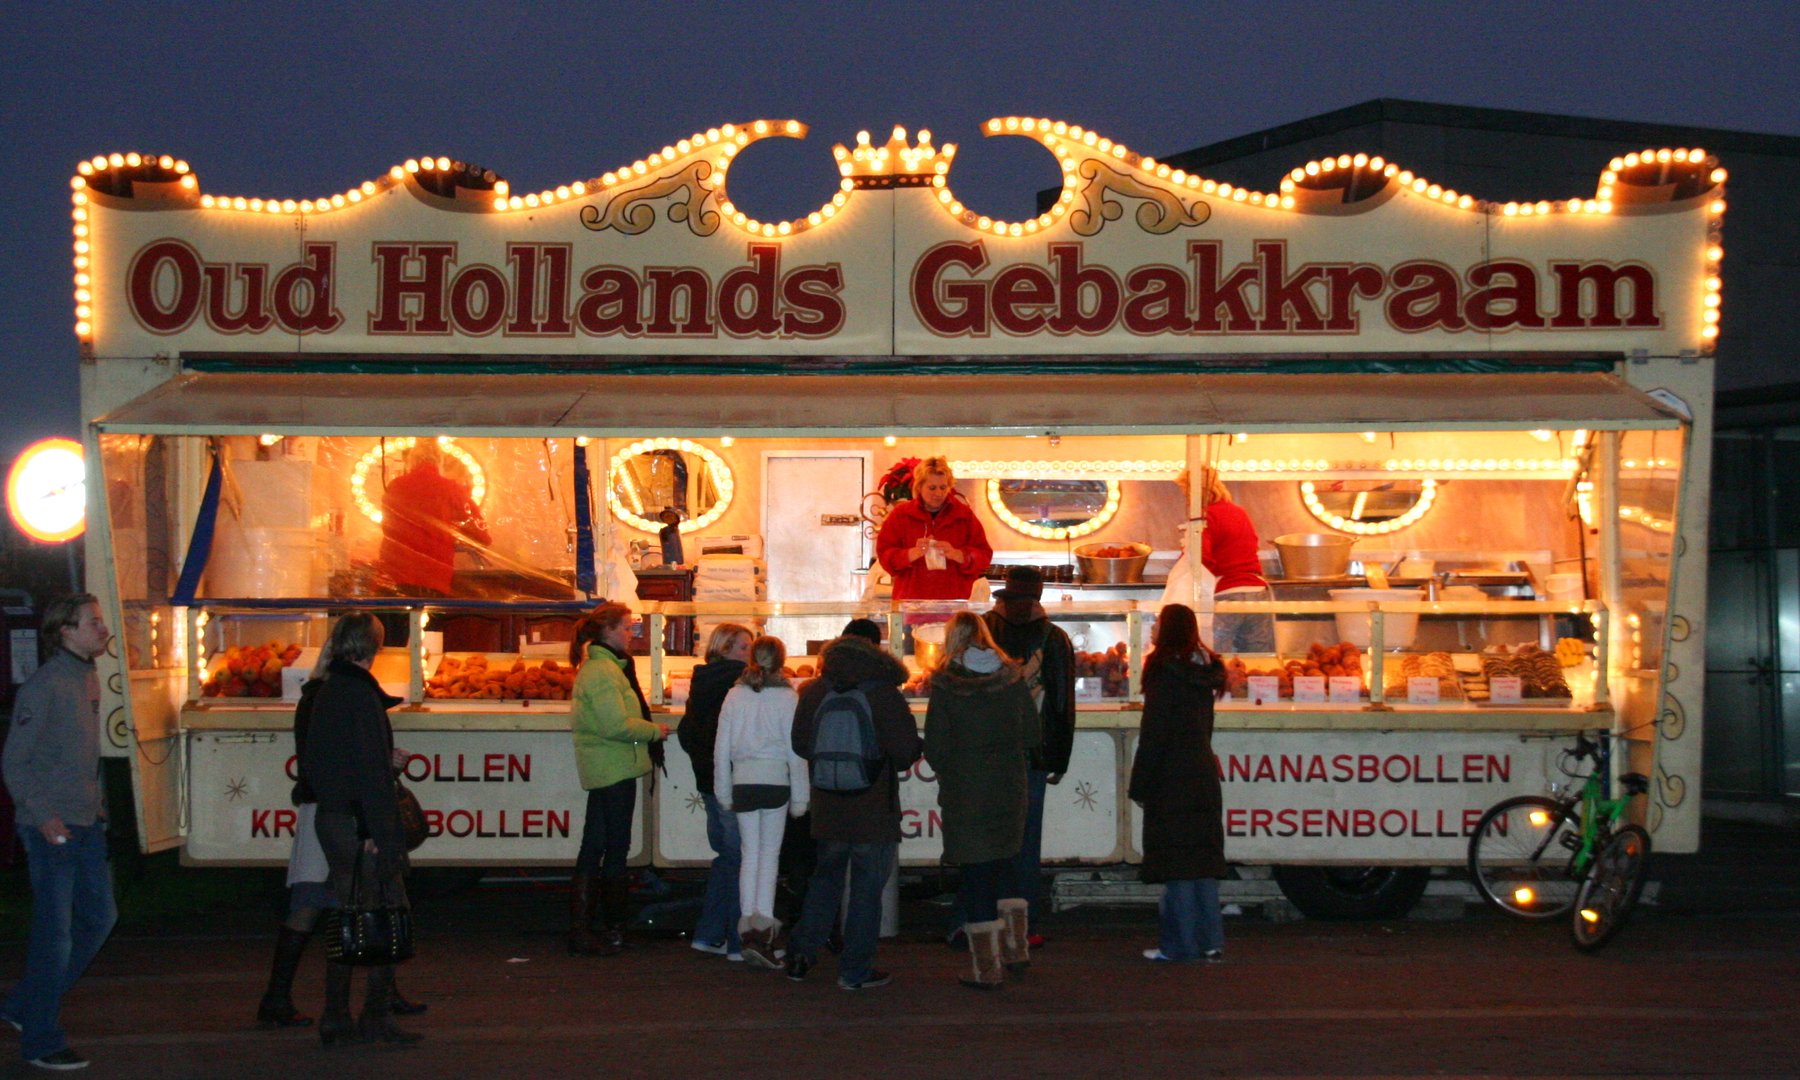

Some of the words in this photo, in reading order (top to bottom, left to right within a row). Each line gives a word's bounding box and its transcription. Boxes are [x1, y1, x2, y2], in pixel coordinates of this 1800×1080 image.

[126, 237, 345, 336] Oud
[367, 240, 846, 339] Hollands
[909, 239, 1665, 338] Gebakkraam
[252, 808, 569, 838] KRBOLLEN
[1226, 808, 1508, 838] ERSENBOLLEN
